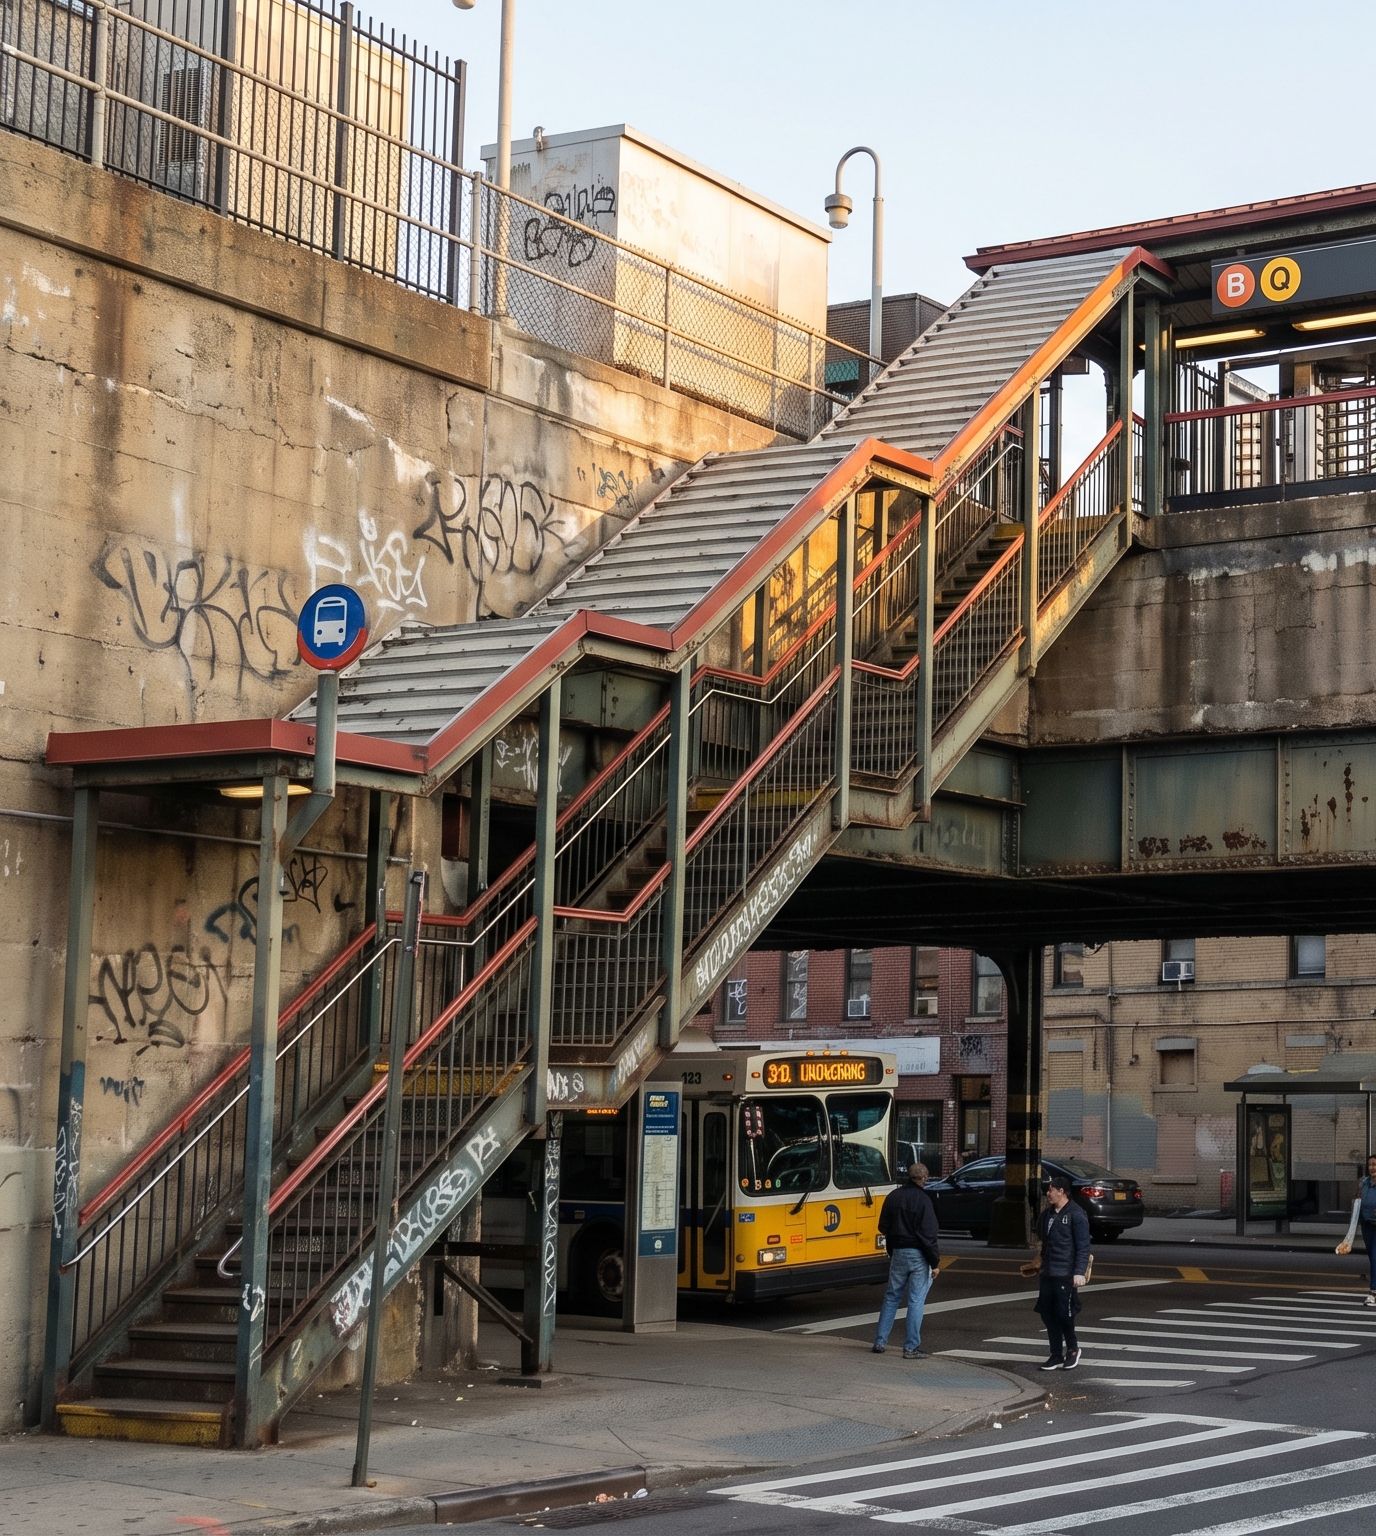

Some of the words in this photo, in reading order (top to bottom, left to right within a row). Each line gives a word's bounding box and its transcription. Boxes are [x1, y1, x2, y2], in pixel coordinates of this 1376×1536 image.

[1227, 272, 1245, 298] B
[1270, 266, 1290, 291] Q
[681, 1072, 701, 1085] 123
